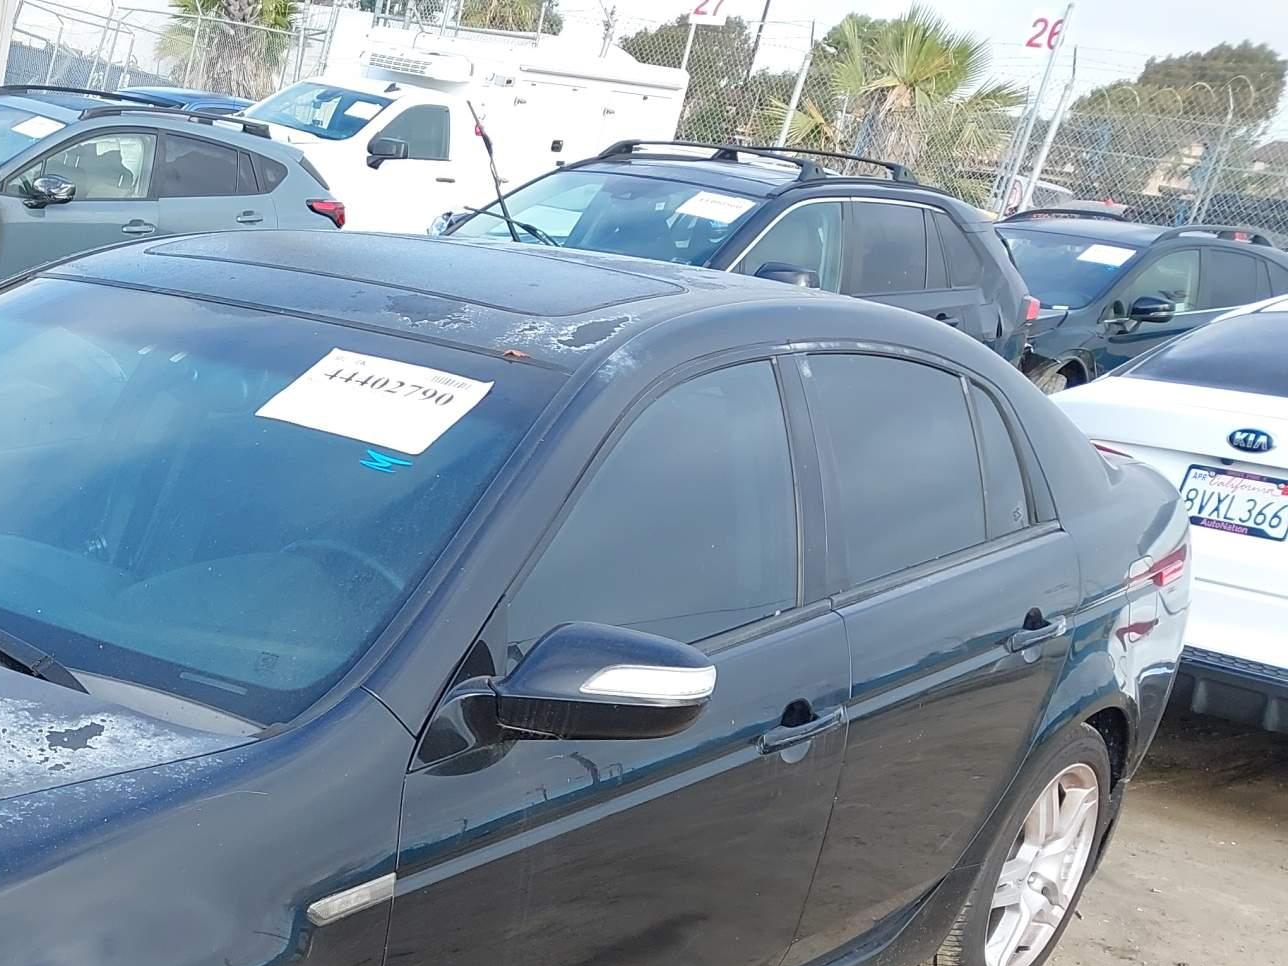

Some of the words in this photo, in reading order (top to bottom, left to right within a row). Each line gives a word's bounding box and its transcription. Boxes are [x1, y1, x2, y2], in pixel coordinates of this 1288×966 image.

[1025, 17, 1064, 50] 26
[324, 368, 454, 406] 44402790
[1232, 431, 1269, 450] KIA
[1192, 471, 1208, 480] APR
[1208, 476, 1276, 494] California
[1184, 488, 1288, 529] 8VXL366
[1200, 518, 1249, 534] AutoNation
